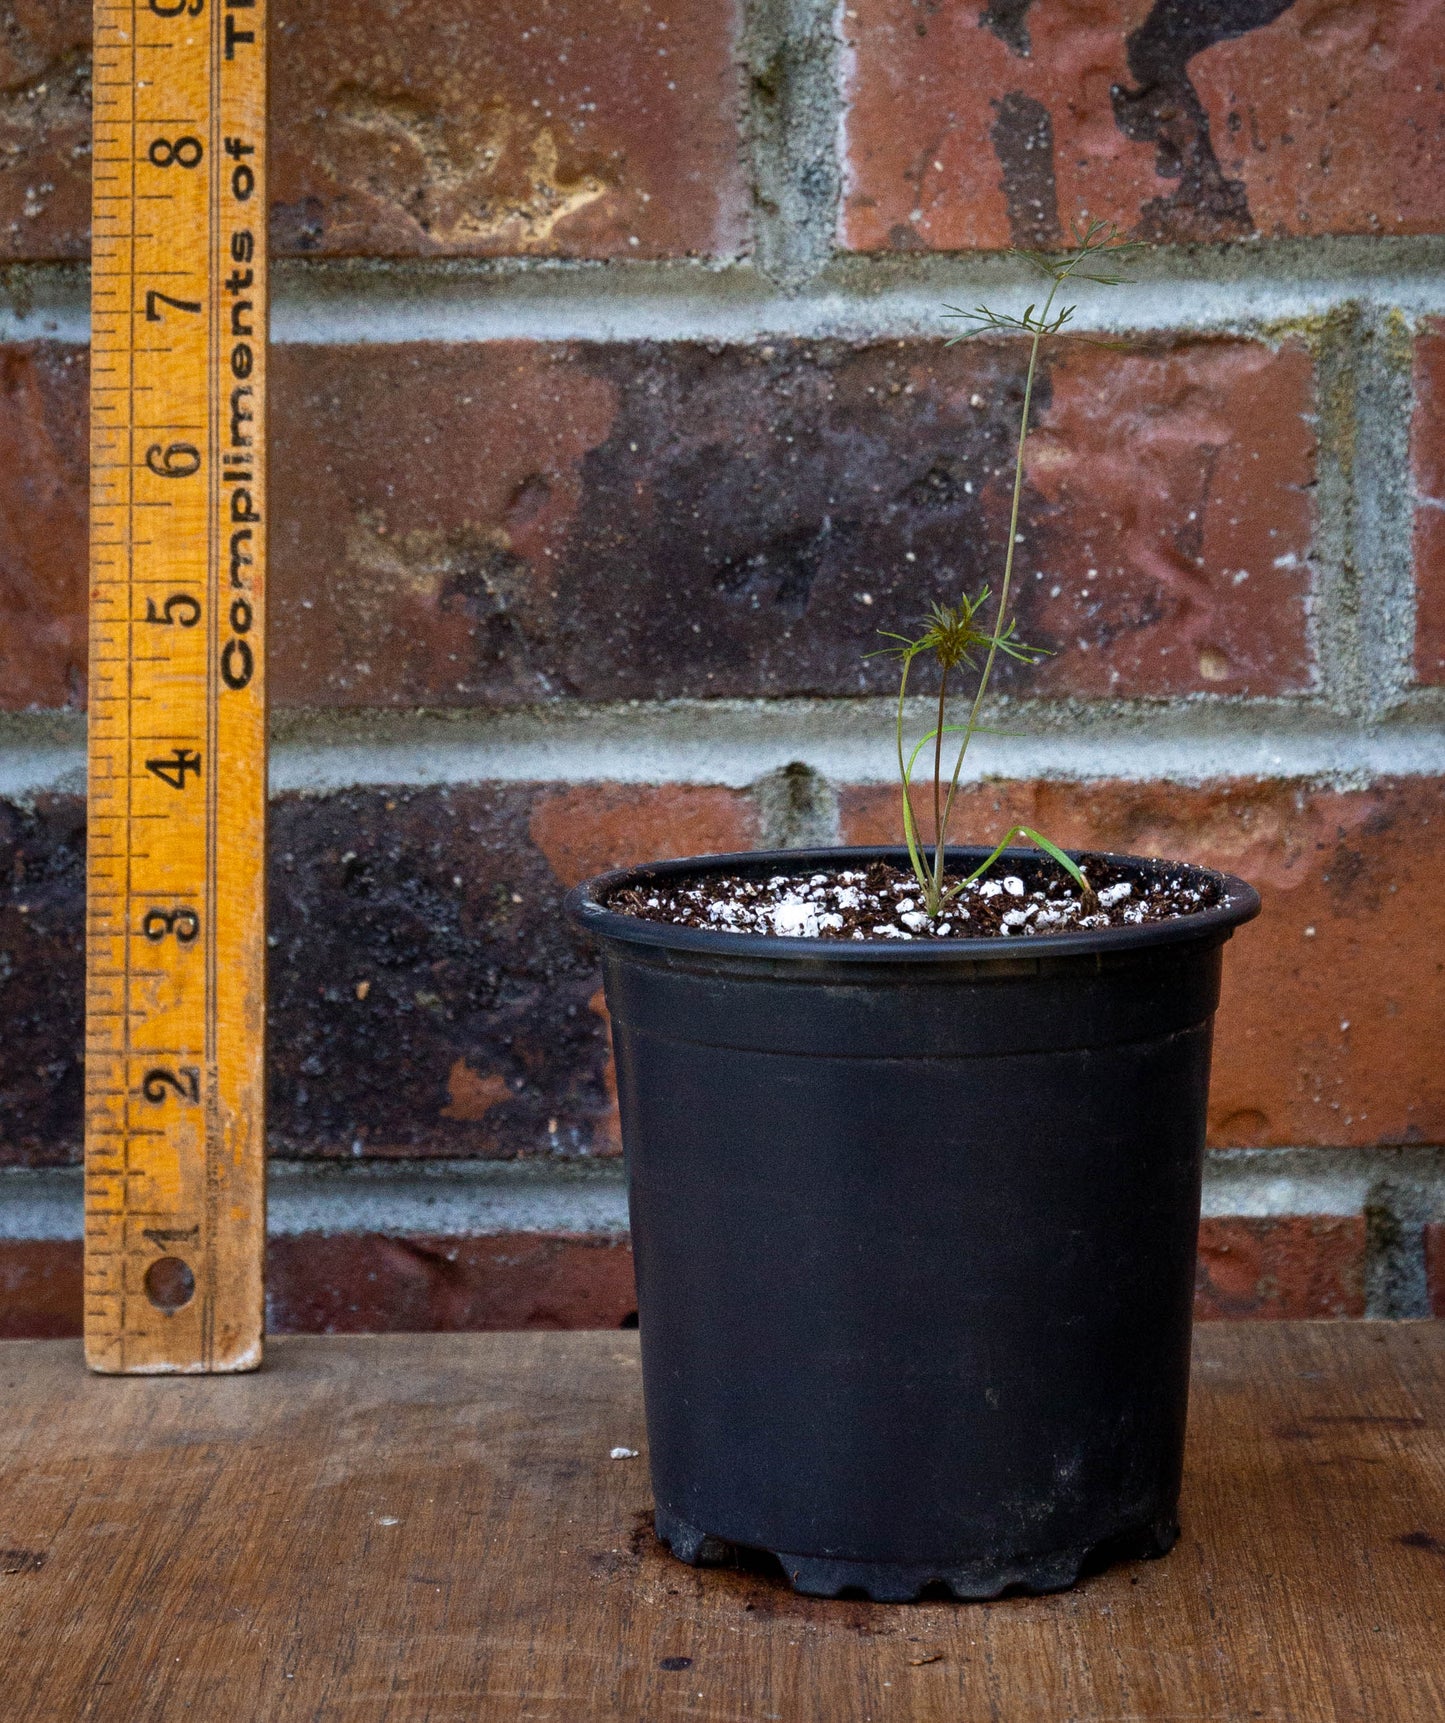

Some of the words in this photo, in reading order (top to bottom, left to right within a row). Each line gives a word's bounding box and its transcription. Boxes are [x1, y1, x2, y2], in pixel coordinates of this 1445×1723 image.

[149, 136, 203, 169] 8
[224, 137, 255, 201] of
[145, 290, 201, 321] 7
[146, 443, 200, 478] 6
[221, 230, 262, 690] Compliments
[145, 594, 201, 628] 5
[145, 749, 201, 790] 4
[143, 908, 199, 942] 3
[143, 1067, 199, 1104] 2
[143, 1224, 199, 1251] 1
